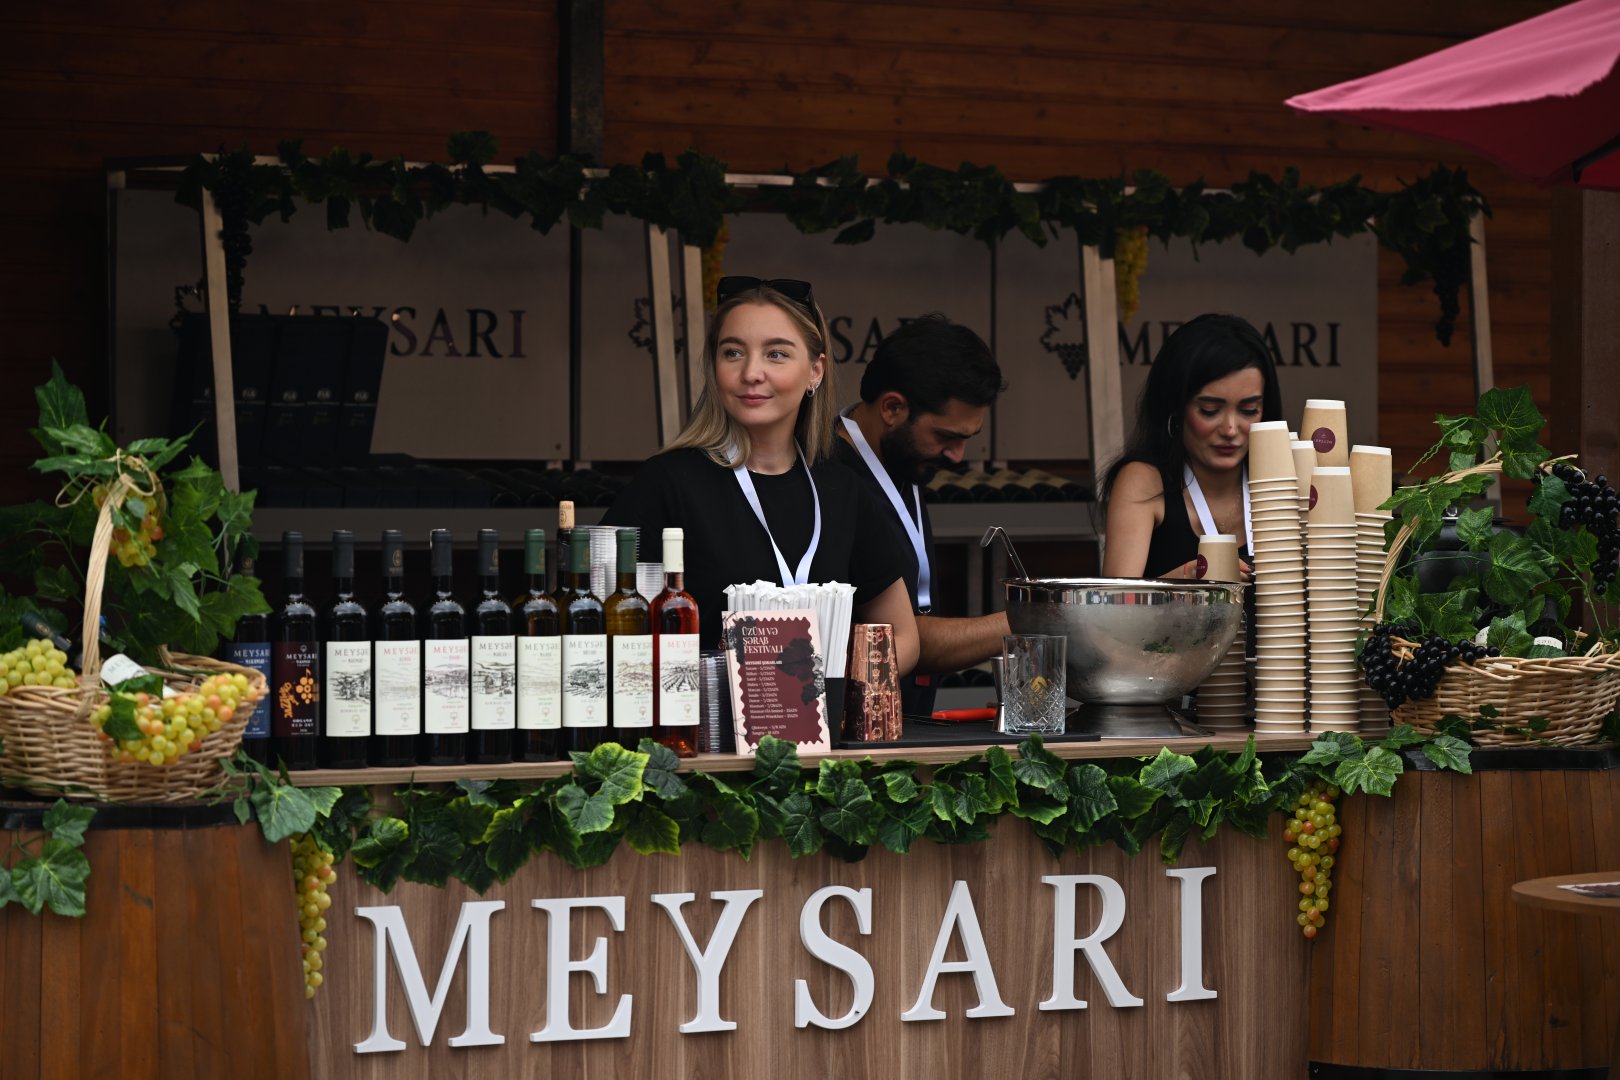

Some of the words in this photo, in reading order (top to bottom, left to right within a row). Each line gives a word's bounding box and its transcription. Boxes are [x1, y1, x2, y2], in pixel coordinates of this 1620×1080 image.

[1117, 320, 1342, 367] MARI
[742, 626, 766, 636] ÜZÜM
[766, 627, 778, 636] VƏ
[742, 636, 769, 646] ŞƏRAB
[353, 865, 1218, 1055] MEYSARI
